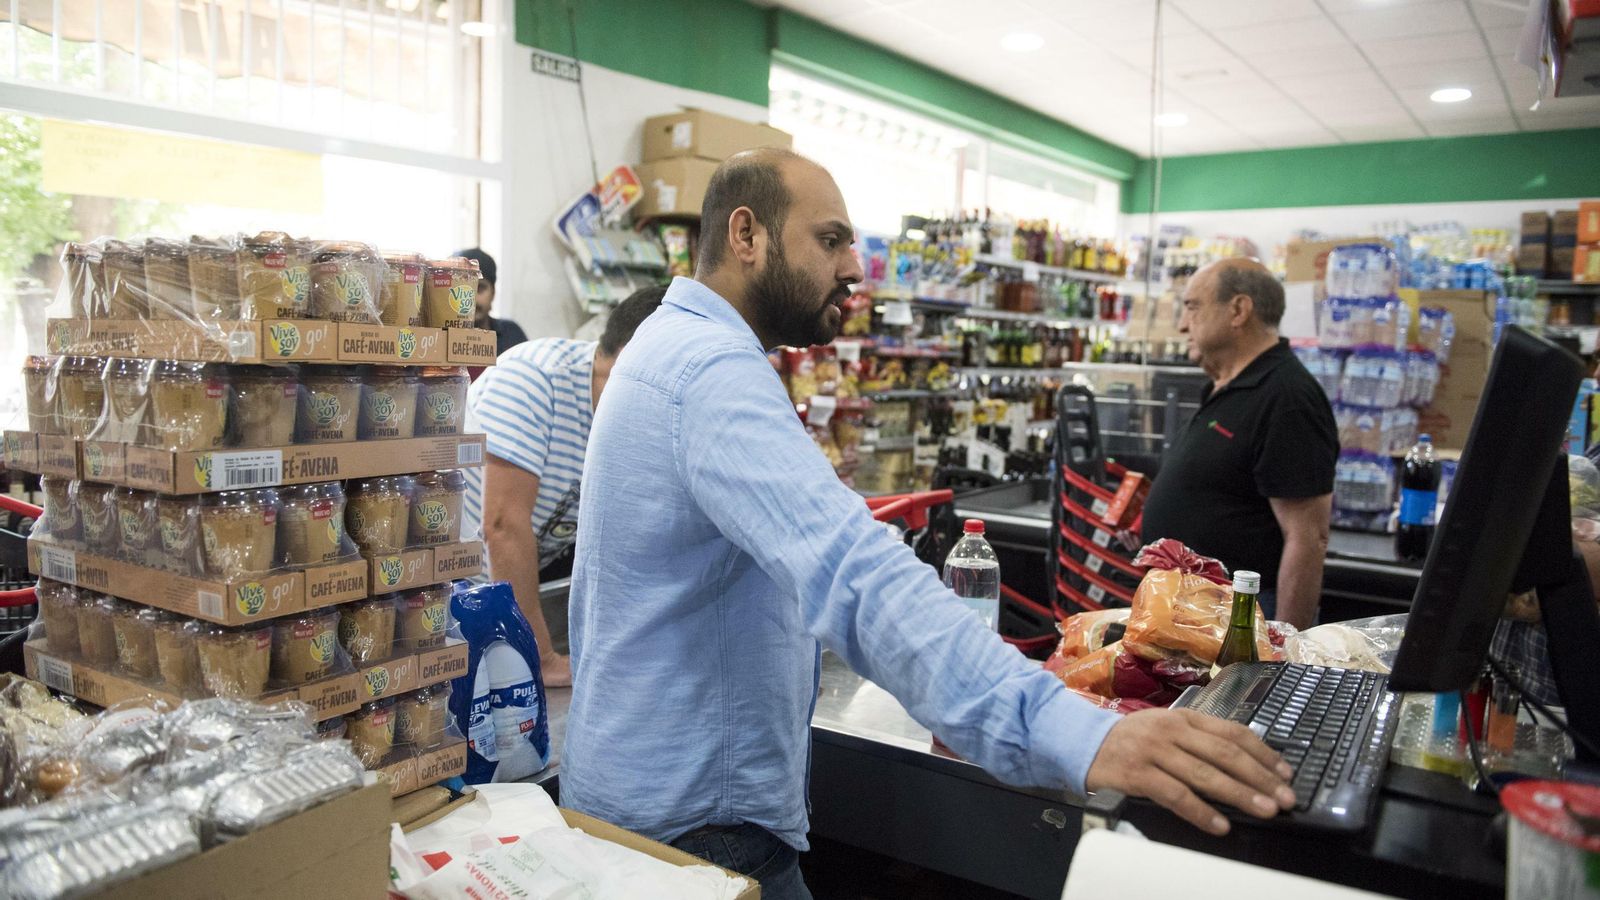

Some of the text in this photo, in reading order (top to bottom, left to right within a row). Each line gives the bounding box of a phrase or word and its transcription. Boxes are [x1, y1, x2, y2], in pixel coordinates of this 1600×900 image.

[534, 54, 579, 80] SALIDA
[450, 287, 474, 301] Vive
[270, 324, 296, 340] Vive
[303, 324, 328, 356] go!
[280, 337, 299, 350] soy
[400, 341, 416, 352] soy
[419, 331, 438, 359] go!
[425, 394, 452, 408] Vive
[318, 405, 340, 417] soy
[375, 403, 395, 417] soy
[435, 403, 454, 416] soy
[282, 456, 339, 479] FÉ·AVENA
[417, 504, 444, 517] Vive
[427, 512, 447, 524] soy
[380, 558, 401, 574] Vive
[388, 565, 404, 580] soy
[405, 553, 426, 582] go!
[237, 583, 263, 602] Vive
[270, 577, 295, 611] go!
[247, 593, 265, 610] soy
[365, 669, 386, 686] Vive
[392, 659, 411, 689] go!
[373, 676, 389, 692] soy
[464, 861, 497, 896] HORAS
